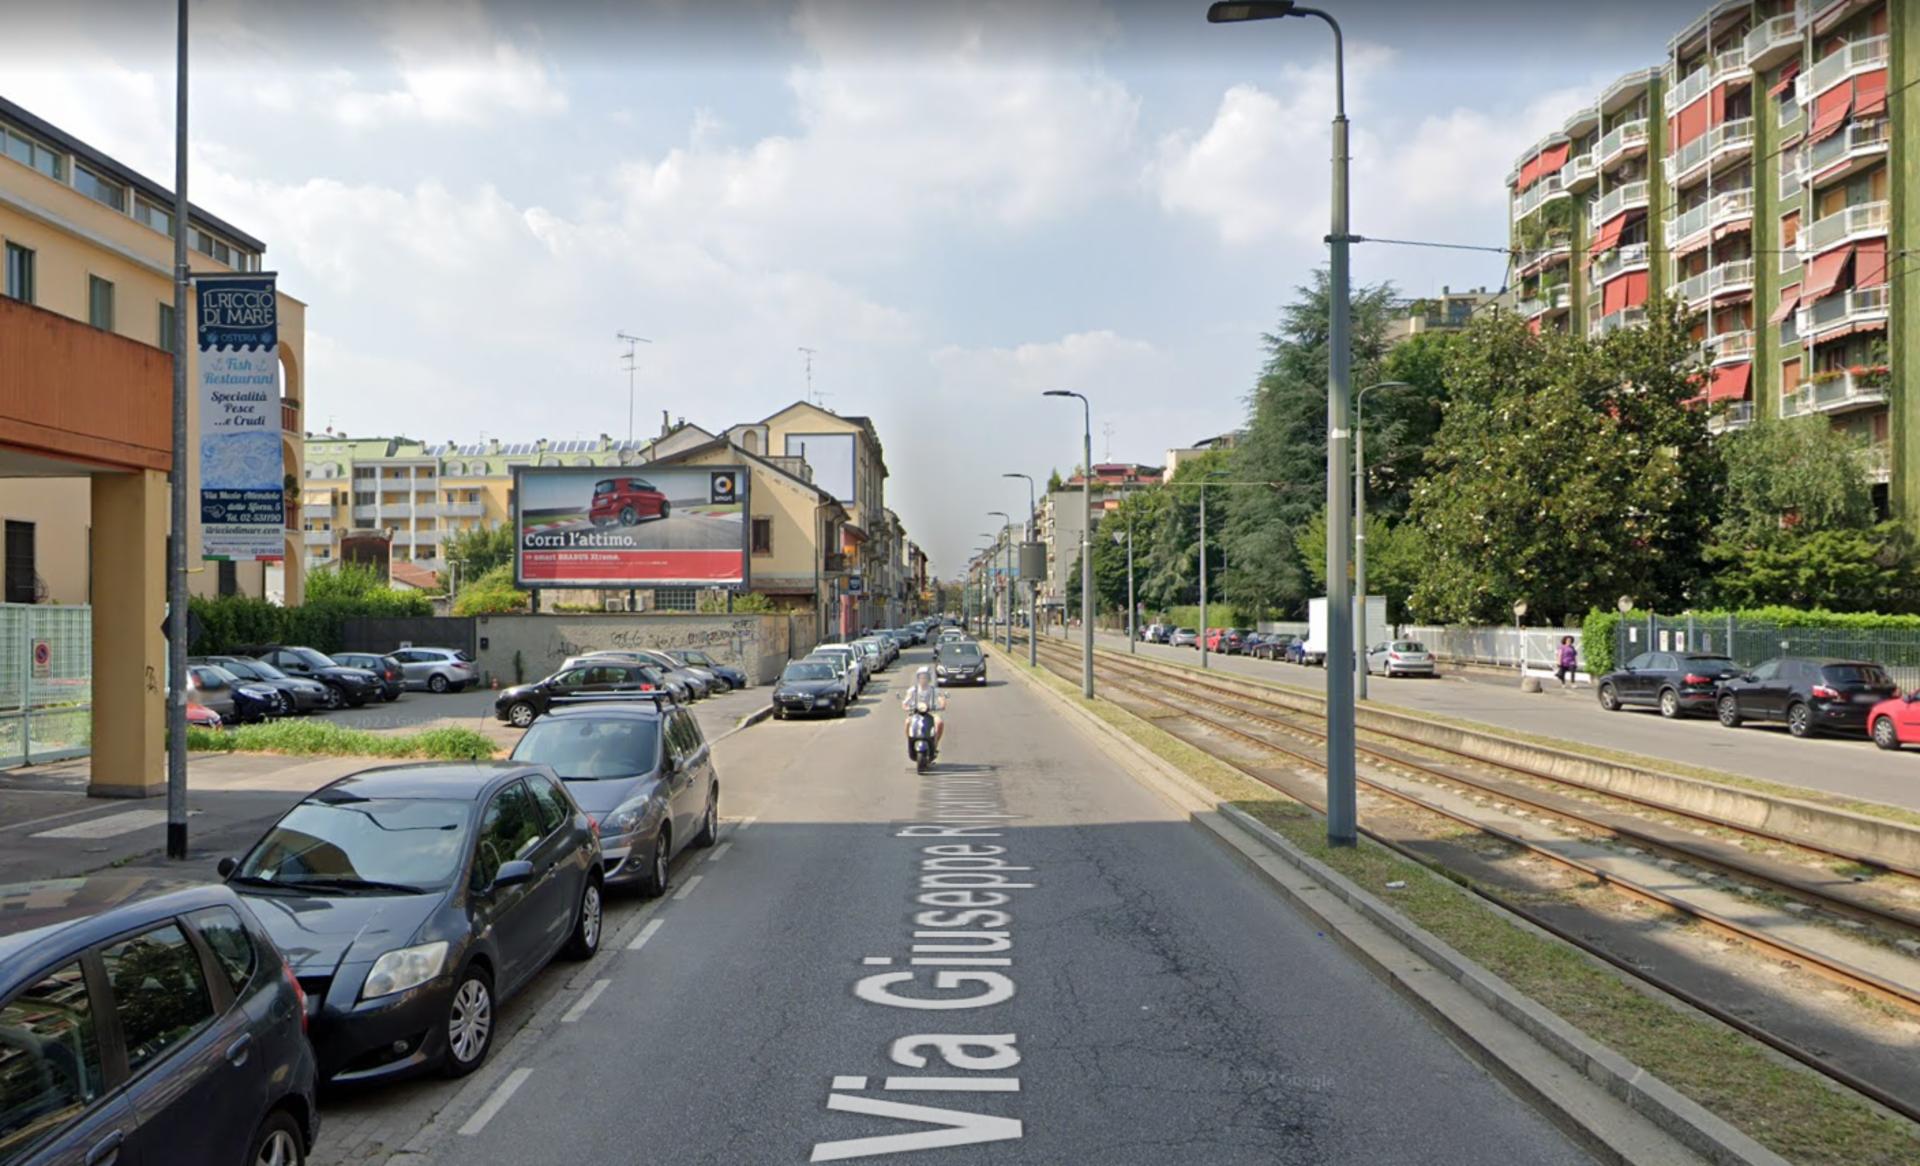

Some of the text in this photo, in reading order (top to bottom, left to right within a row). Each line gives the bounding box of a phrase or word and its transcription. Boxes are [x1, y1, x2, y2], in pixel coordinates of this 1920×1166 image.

[205, 308, 274, 324] DI MARE
[220, 333, 257, 342] OSTERIA
[226, 358, 252, 371] Fish
[204, 372, 274, 385] Restaurant
[210, 390, 267, 404] Specialità
[223, 403, 254, 413] Pesce
[233, 416, 266, 426] Crudi
[204, 491, 218, 500] Via
[205, 525, 281, 535] ilricciodimare.com
[524, 532, 565, 547] Corri
